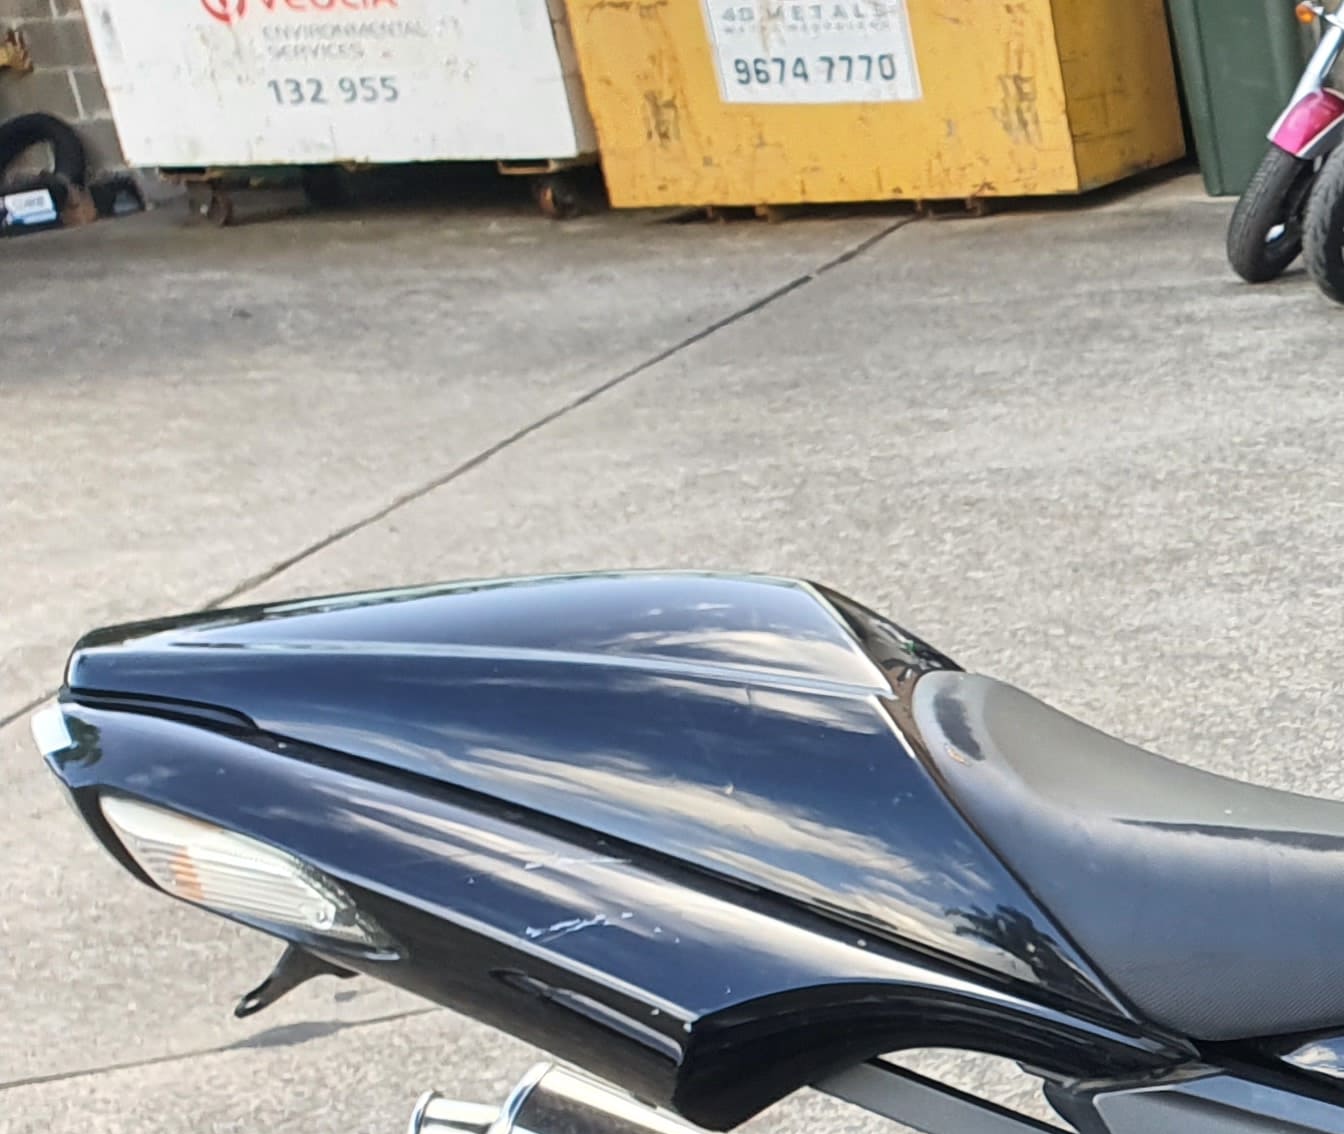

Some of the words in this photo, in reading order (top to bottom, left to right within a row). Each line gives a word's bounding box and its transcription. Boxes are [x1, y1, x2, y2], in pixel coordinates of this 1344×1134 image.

[267, 43, 366, 60] SERVICES
[734, 56, 809, 85] 9674
[818, 53, 897, 82] 7770
[267, 78, 328, 105] 132
[337, 75, 400, 103] 955
